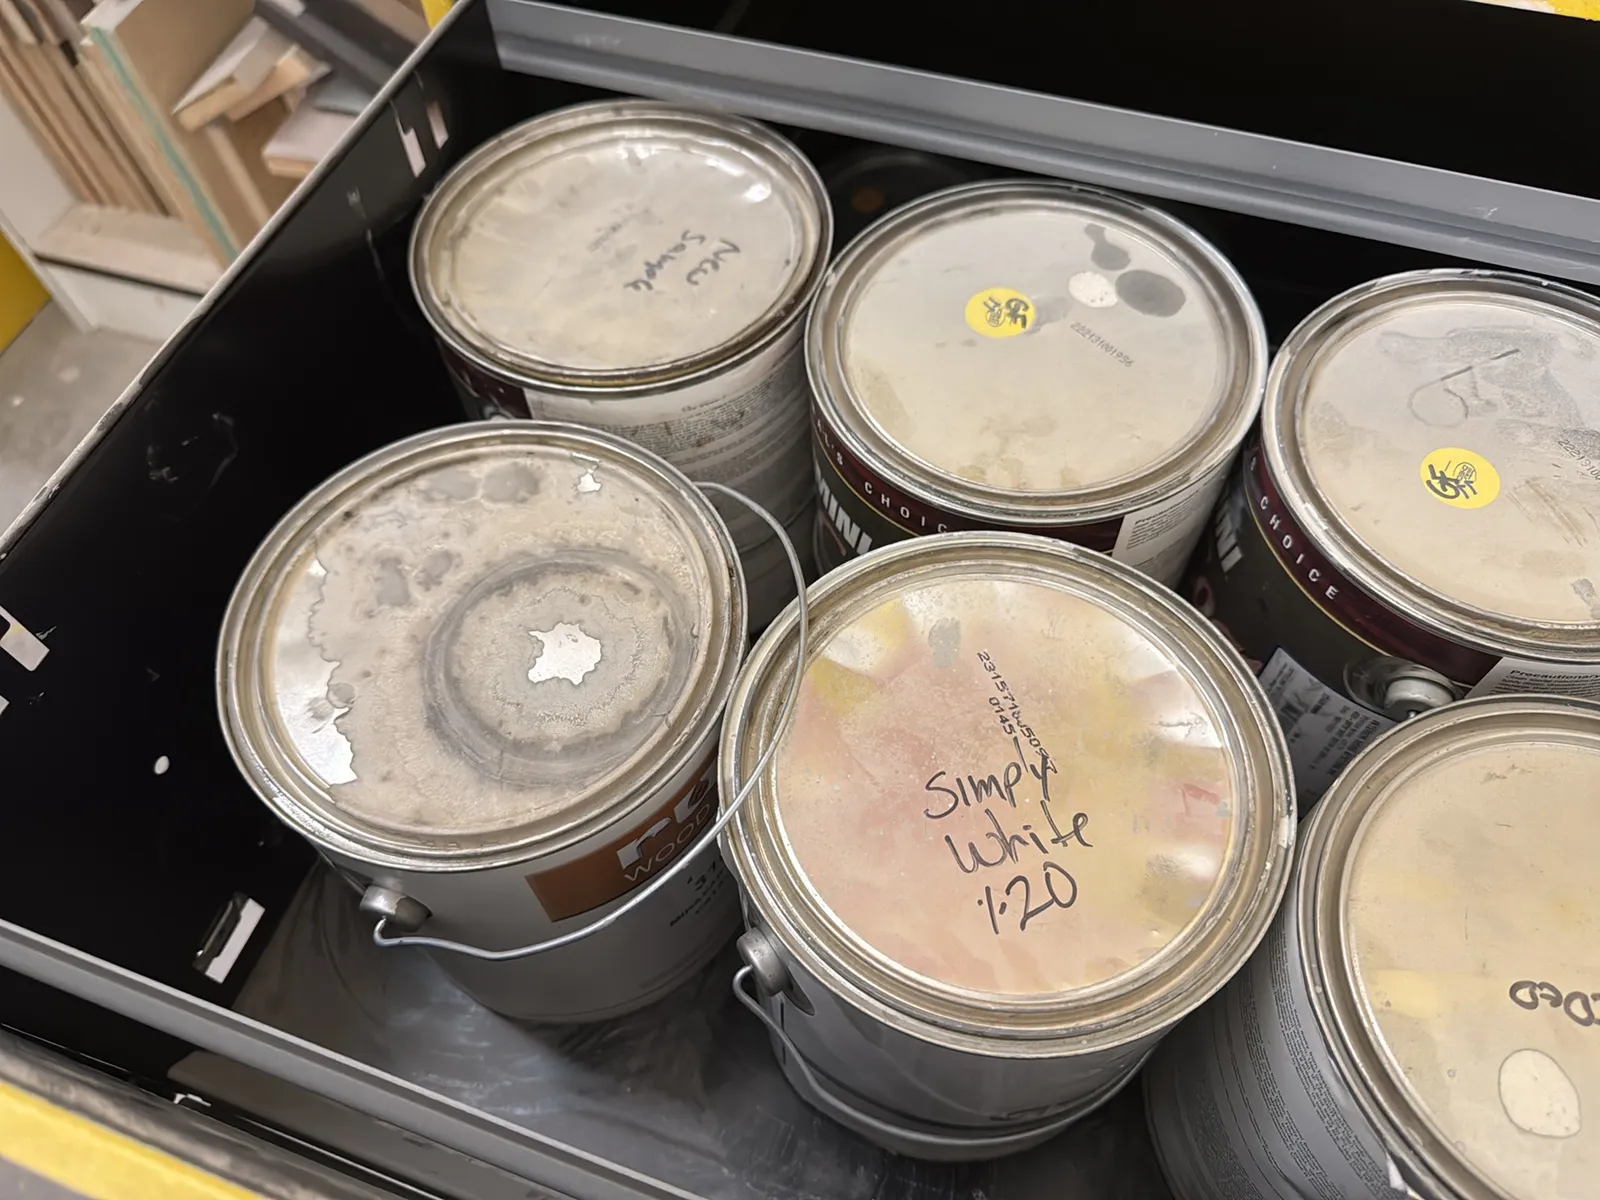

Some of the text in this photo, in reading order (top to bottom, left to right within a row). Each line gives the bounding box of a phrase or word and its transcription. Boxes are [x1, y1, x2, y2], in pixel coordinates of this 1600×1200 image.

[864, 481, 948, 533] CHOIC
[1259, 495, 1341, 600] CHOICE
[988, 696, 1017, 736] 0145
[623, 803, 711, 882] WOOD
[944, 799, 1094, 874] White
[1508, 980, 1600, 1027] DED
